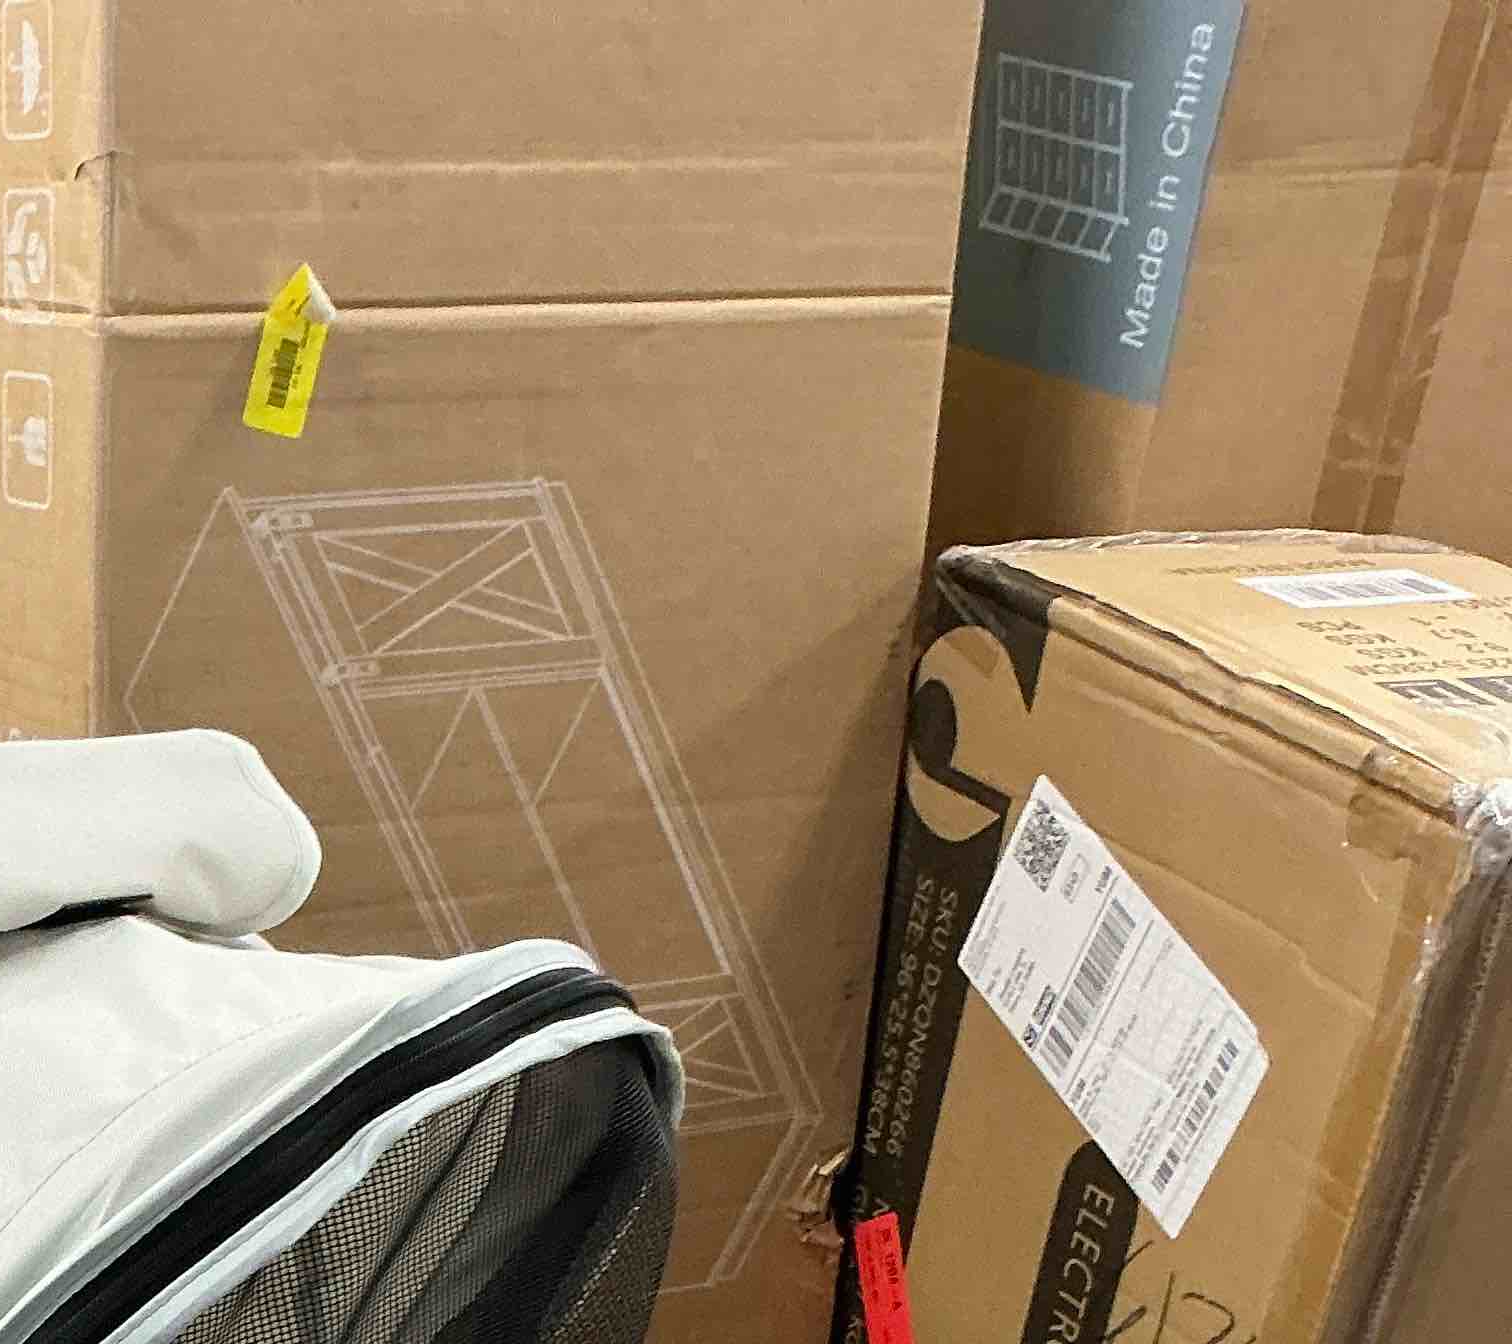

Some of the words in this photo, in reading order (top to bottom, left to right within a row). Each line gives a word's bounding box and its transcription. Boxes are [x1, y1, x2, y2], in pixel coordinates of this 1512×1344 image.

[1160, 21, 1215, 160] China
[1149, 174, 1181, 213] in
[1119, 226, 1169, 349] Made
